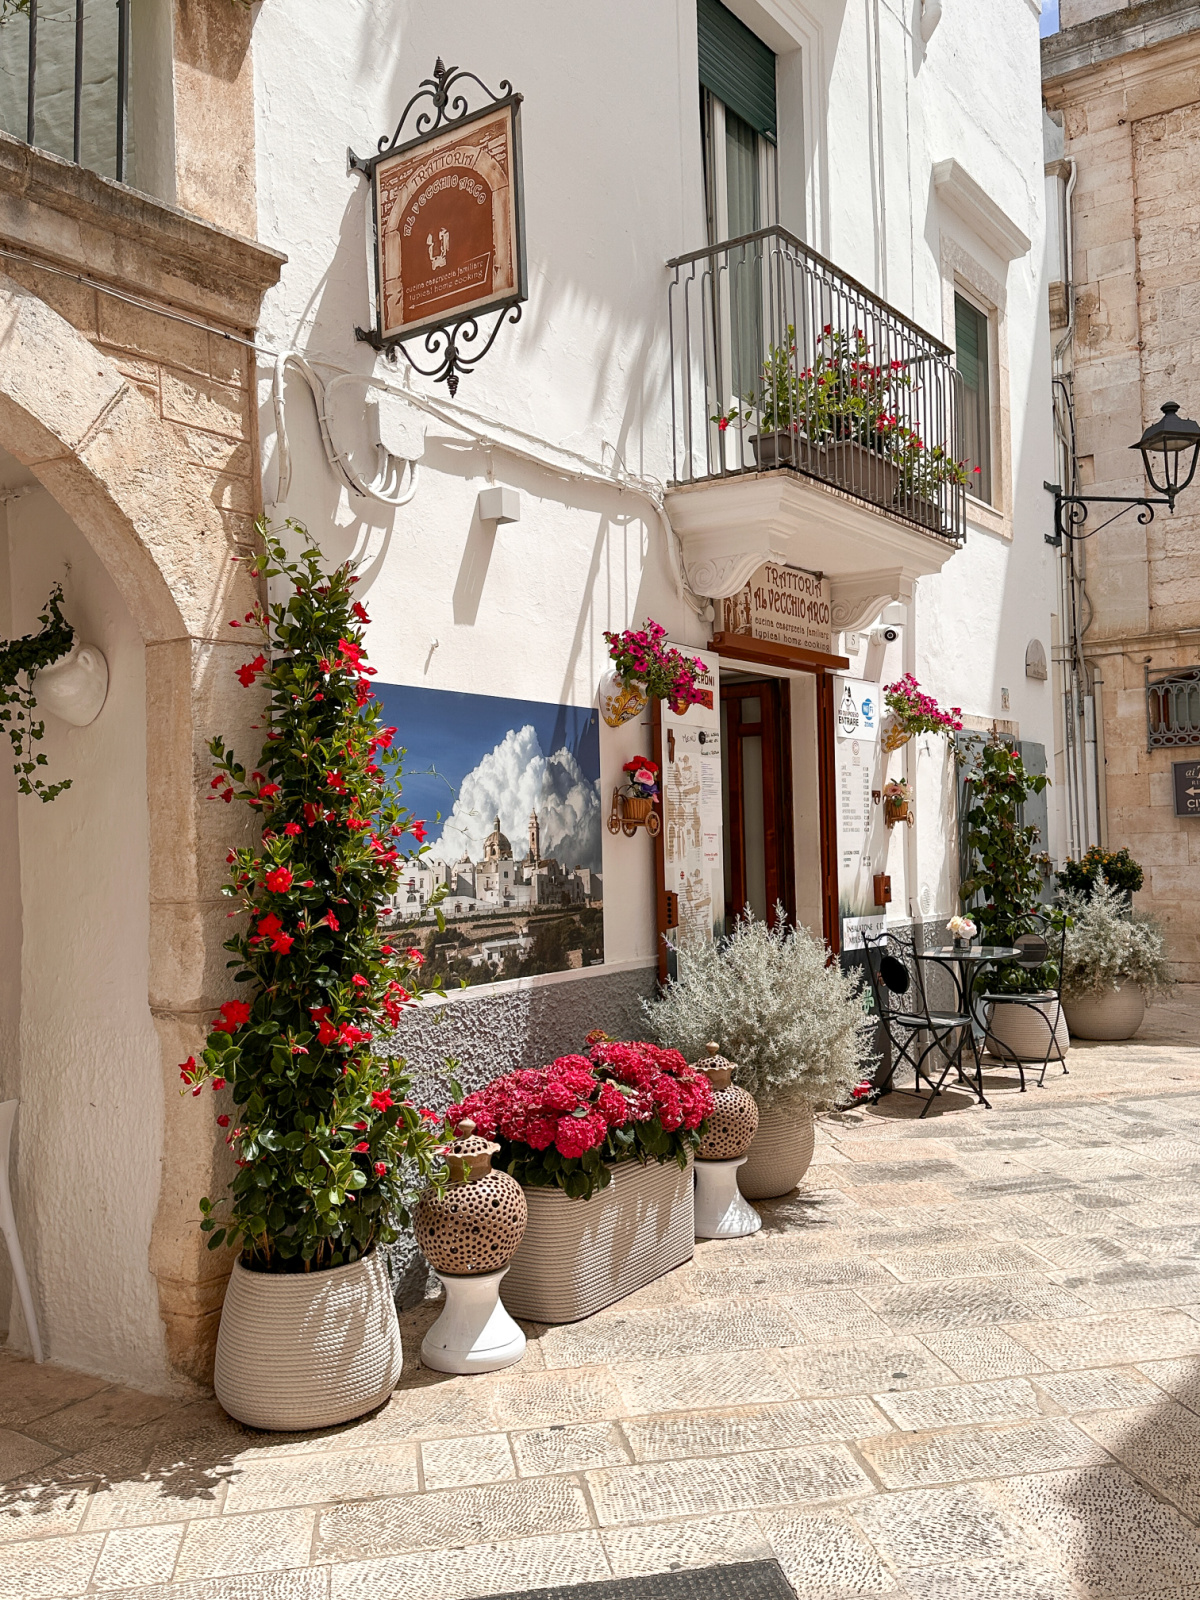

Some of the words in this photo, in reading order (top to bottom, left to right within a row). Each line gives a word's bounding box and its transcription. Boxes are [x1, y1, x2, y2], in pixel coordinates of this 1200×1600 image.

[411, 152, 475, 188] TRATTORIA
[412, 174, 459, 215] VECCHIO
[458, 176, 487, 205] ARCO
[405, 282, 425, 294] cucina
[409, 286, 433, 302] typical
[434, 281, 453, 295] home
[454, 269, 484, 287] cooking
[764, 565, 822, 599] TRATTORIA
[753, 586, 767, 612] AL
[806, 600, 830, 625] ARCO
[754, 616, 774, 628] cucina
[755, 628, 781, 641] typical
[783, 634, 802, 646] home
[804, 641, 831, 654] cooking
[695, 674, 715, 687] ERONI
[838, 716, 860, 727] ENTRARE
[1186, 799, 1200, 808] CI
